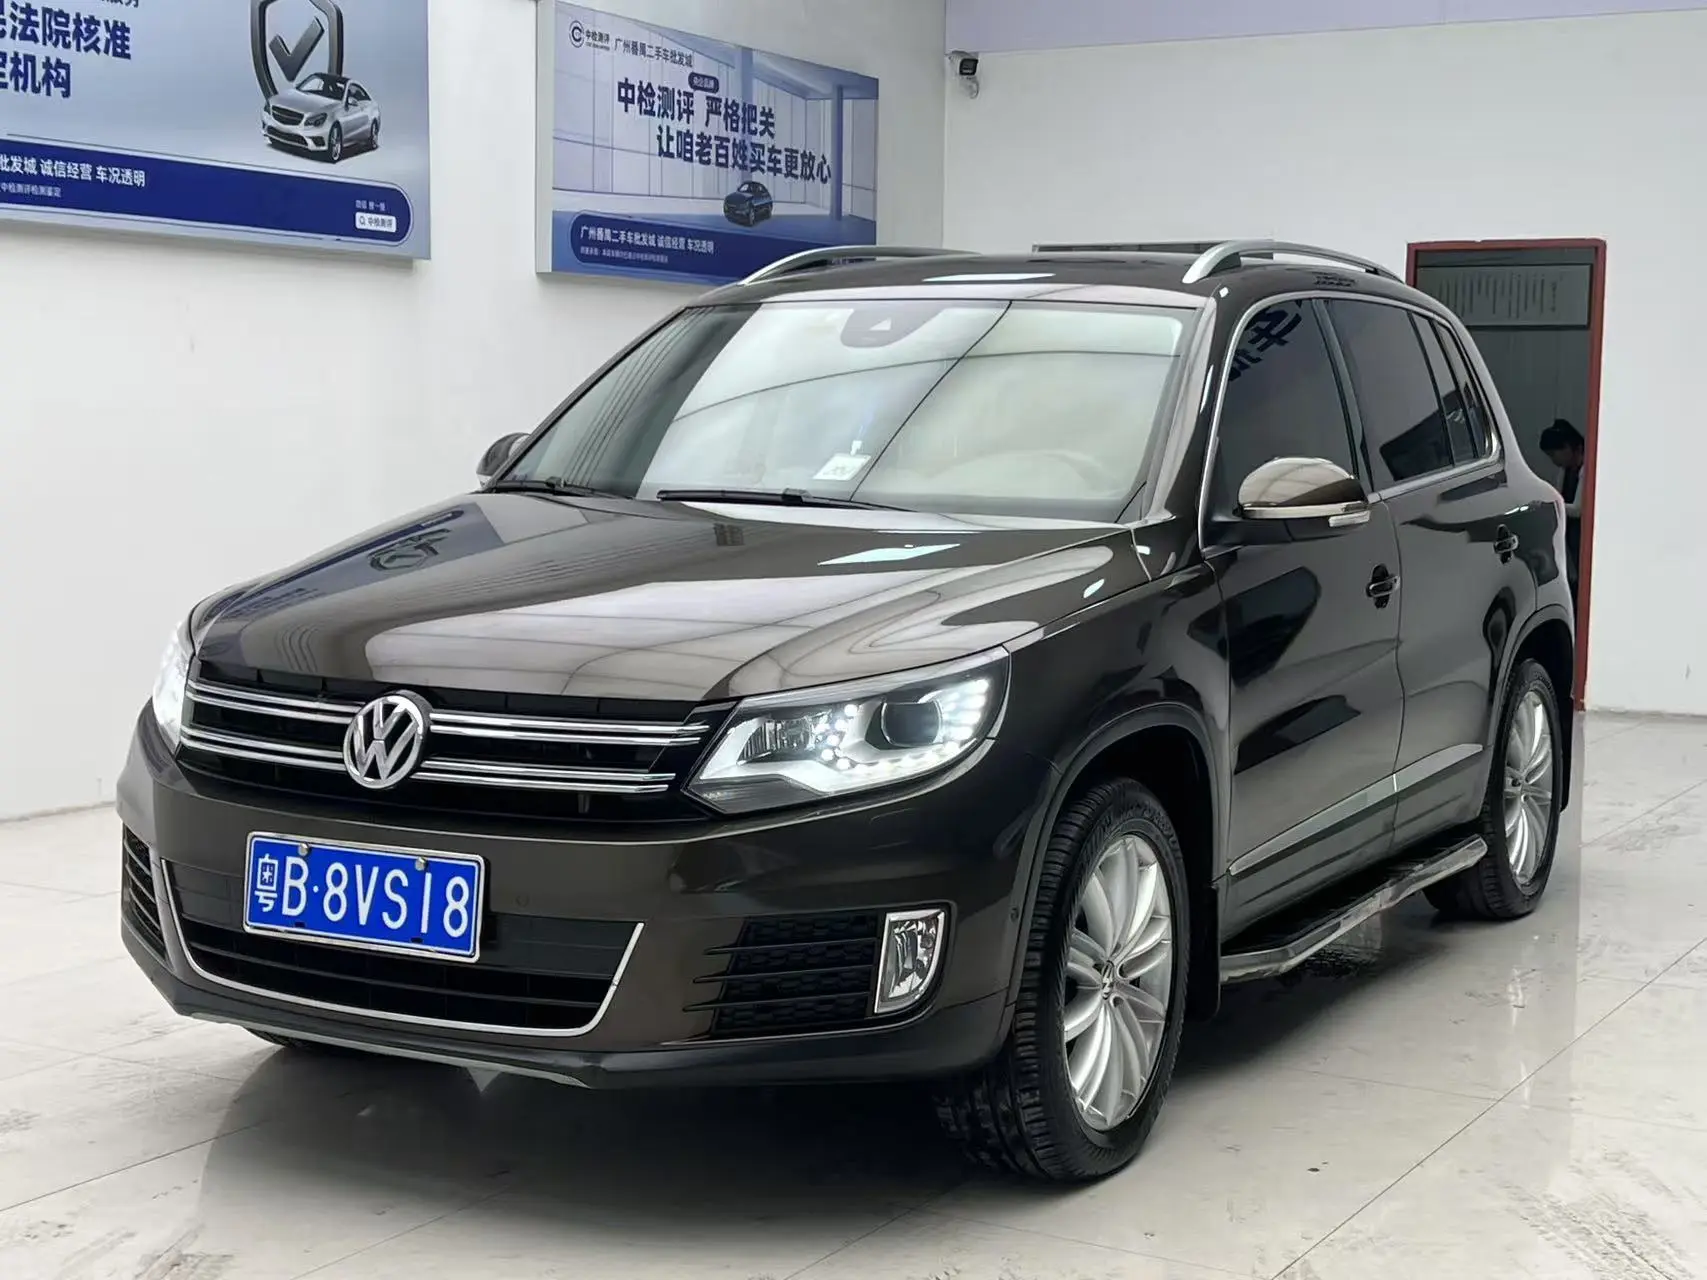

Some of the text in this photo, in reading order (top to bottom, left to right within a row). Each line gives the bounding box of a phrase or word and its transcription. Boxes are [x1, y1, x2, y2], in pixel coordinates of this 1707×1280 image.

[0, 0, 131, 60] 法院核准
[0, 51, 71, 98] 机构
[617, 77, 775, 139] 中检测评 严格把关
[40, 159, 93, 181] 诚信经营
[96, 165, 146, 187] 车况透明
[656, 125, 832, 184] 让咱老百姓买车更放心
